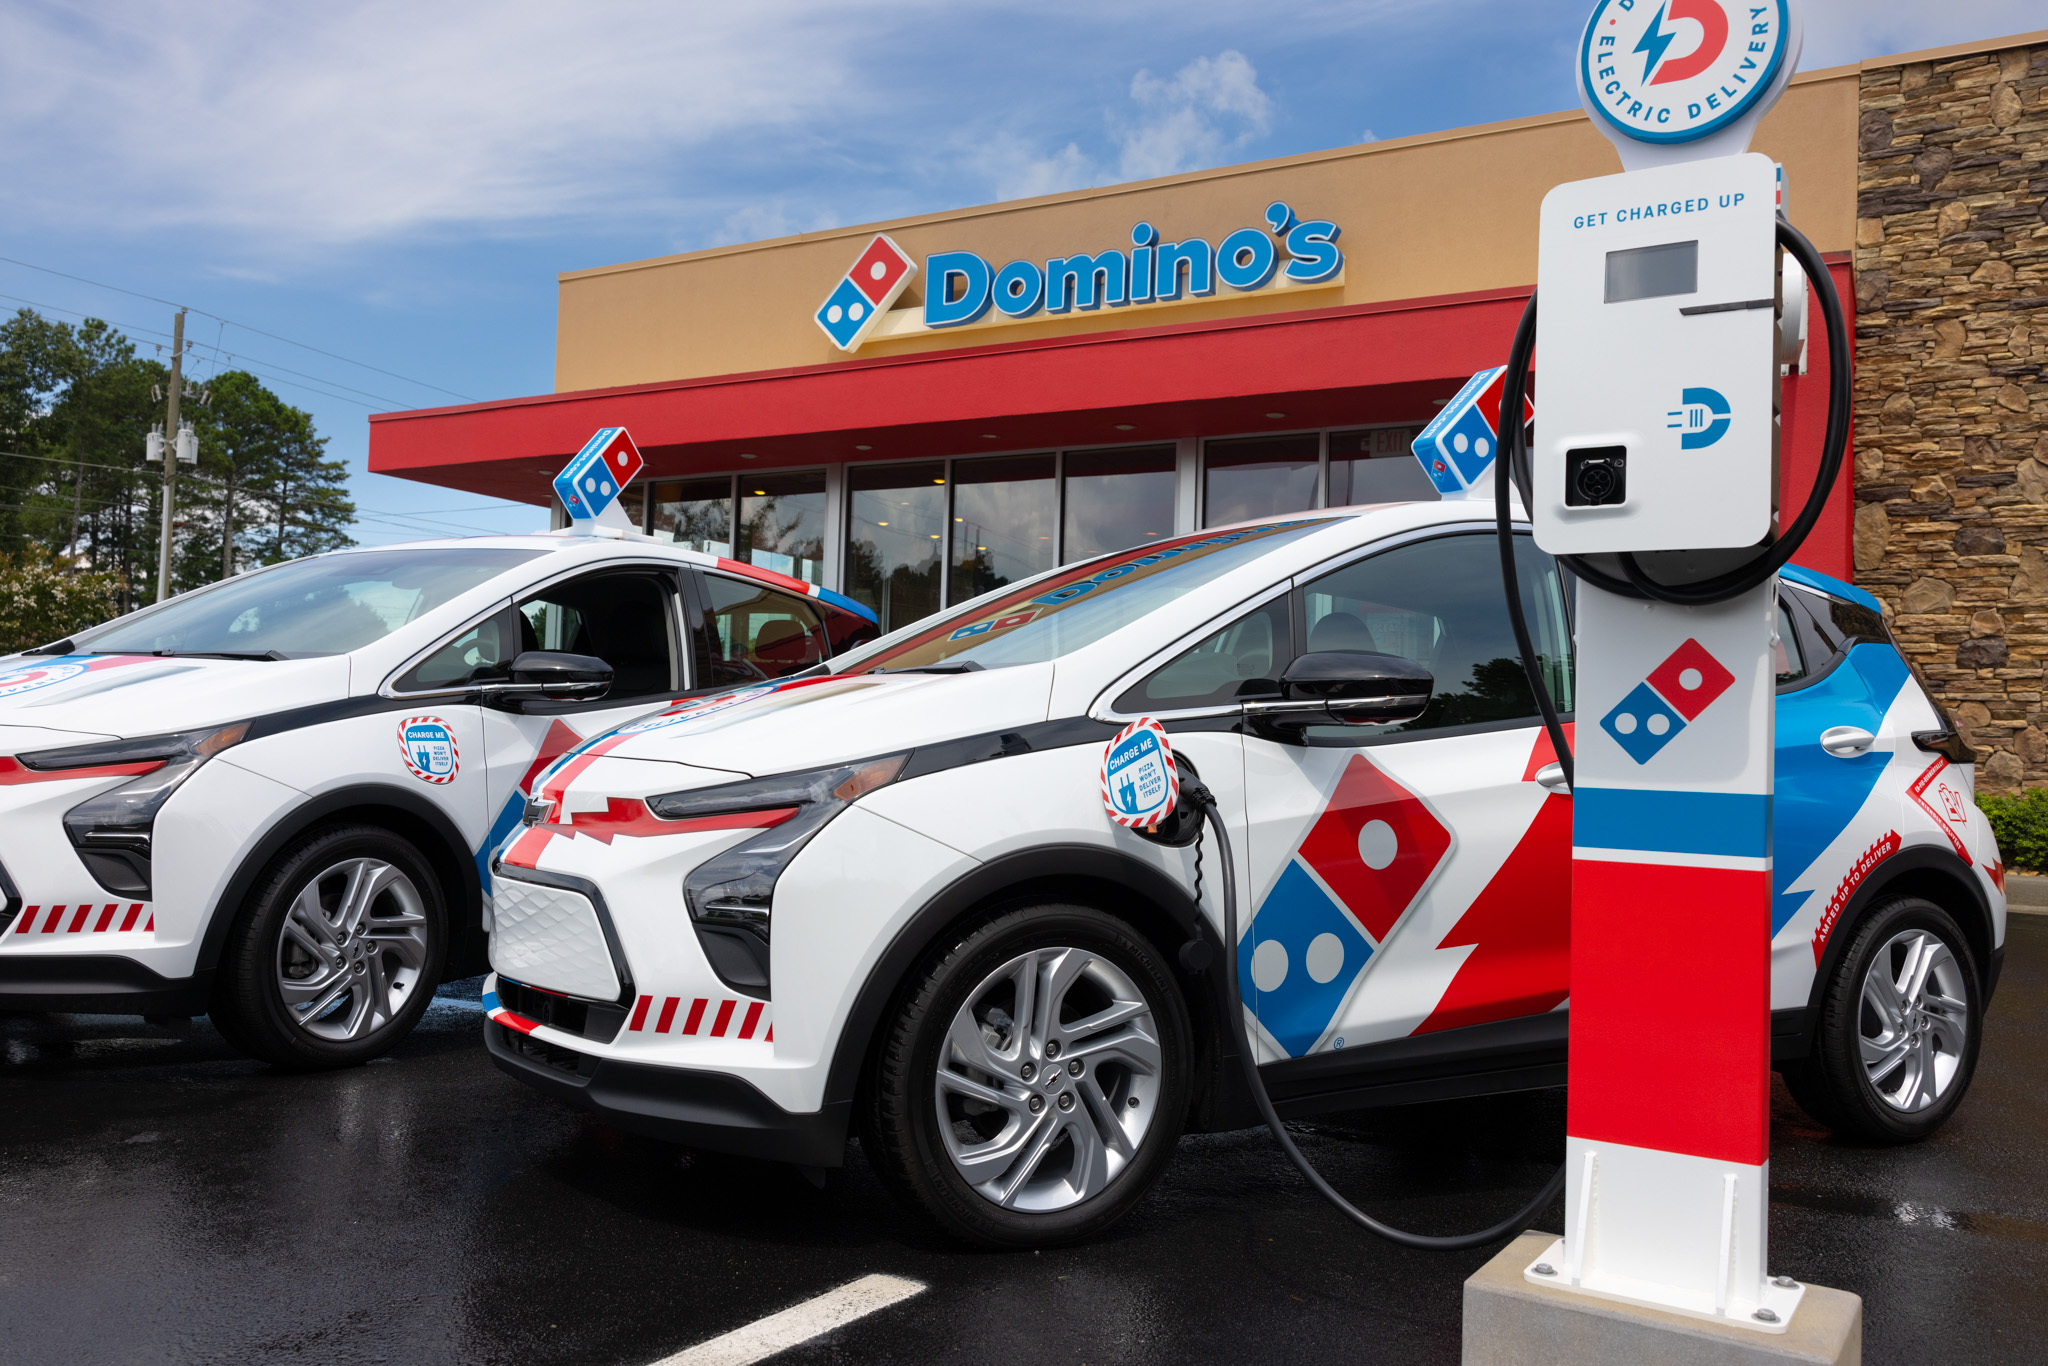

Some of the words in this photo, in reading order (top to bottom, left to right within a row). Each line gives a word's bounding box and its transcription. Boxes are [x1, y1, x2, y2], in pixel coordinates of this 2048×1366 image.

[1597, 36, 1670, 123] ELECTRIC
[1687, 5, 1769, 120] DELIVERY
[1574, 212, 1608, 229] GET
[1616, 198, 1709, 223] CHARGED
[1719, 193, 1745, 209] UP
[923, 200, 1345, 330] Domino's
[1377, 431, 1404, 452] EXIT
[1109, 745, 1140, 770] CHARGE
[1140, 737, 1153, 753] ME
[1138, 762, 1154, 774] PIZZA
[1138, 776, 1161, 792] DELIVER
[1139, 769, 1157, 783] WON'T
[1143, 784, 1161, 799] ITSELF
[1918, 798, 1942, 824] FRIENDLY
[1942, 822, 1962, 850] DELIVERY
[1819, 902, 1840, 943] AMPED
[1839, 886, 1850, 901] UP
[1849, 872, 1860, 886] TO
[1860, 842, 1892, 873] DELIVER
